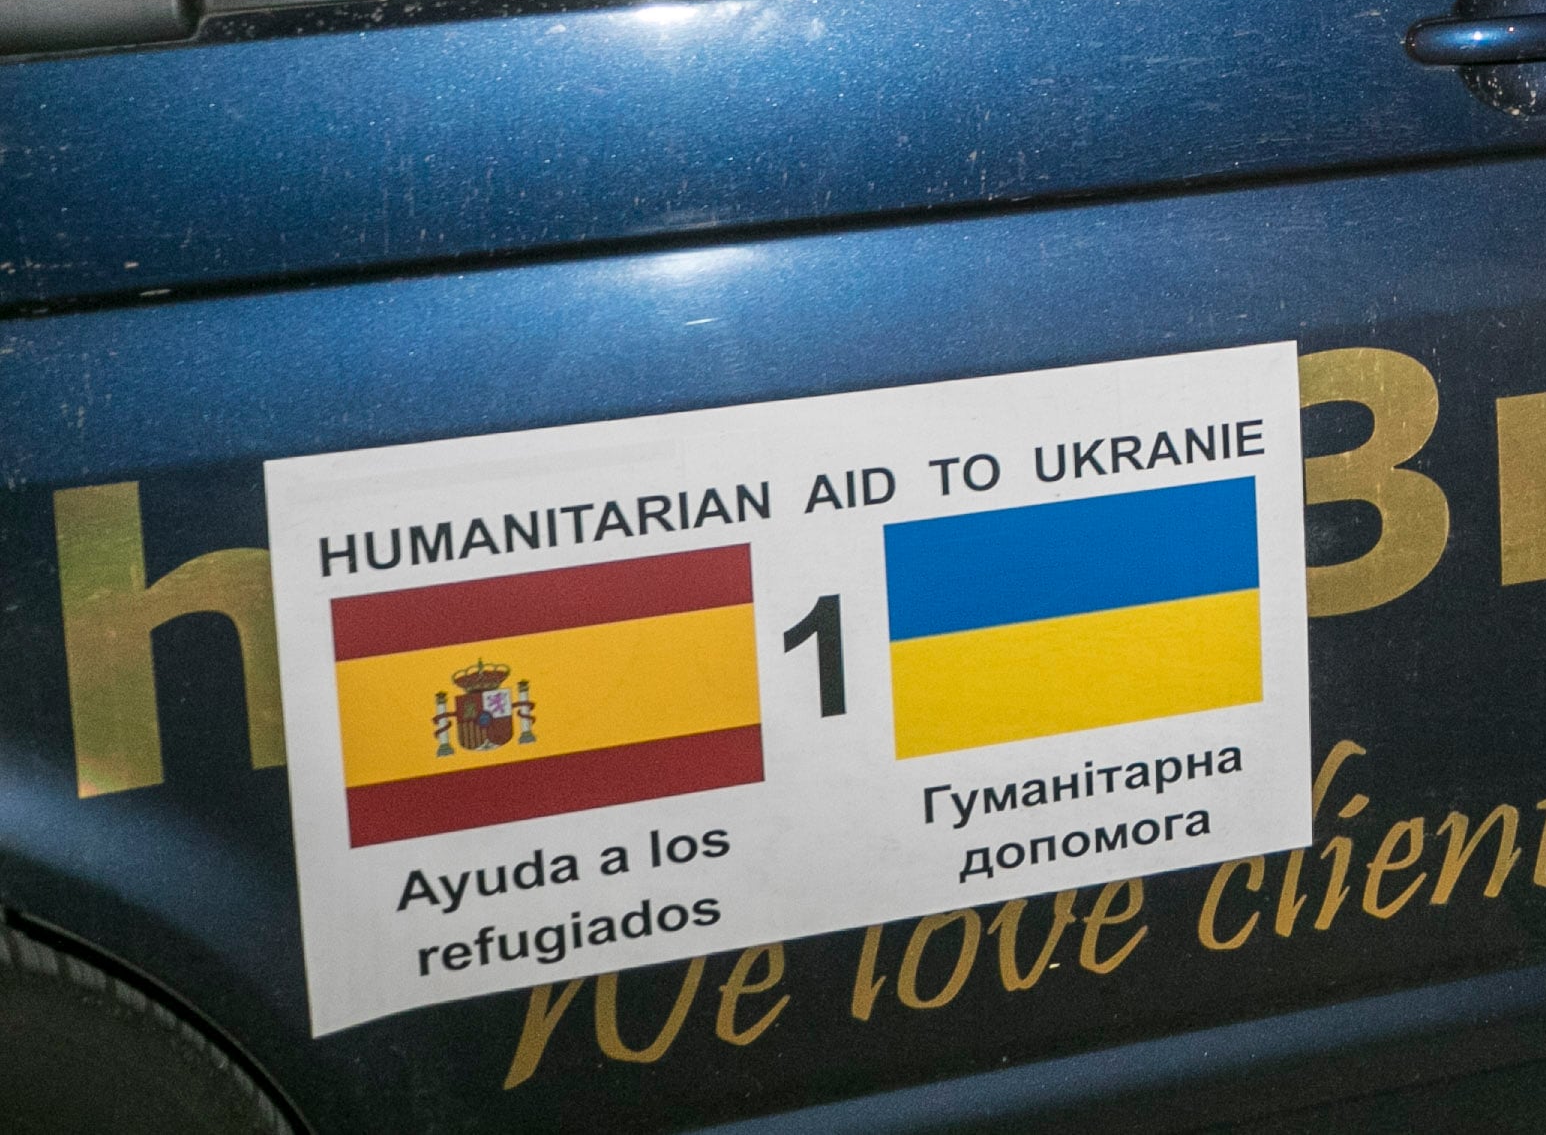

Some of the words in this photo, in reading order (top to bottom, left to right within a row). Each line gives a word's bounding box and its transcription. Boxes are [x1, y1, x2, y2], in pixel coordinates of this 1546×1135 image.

[319, 480, 772, 577] HUMANITARIAN
[804, 467, 896, 514] AID
[928, 453, 1001, 496] TO
[1034, 418, 1266, 483] UKRANIE
[782, 594, 848, 720] 1
[924, 745, 1243, 829] Гуманітарна
[396, 849, 580, 914] Ayuda
[599, 845, 630, 877] a
[650, 828, 731, 868] los
[959, 809, 1211, 884] допомога
[418, 899, 722, 977] refugiados
